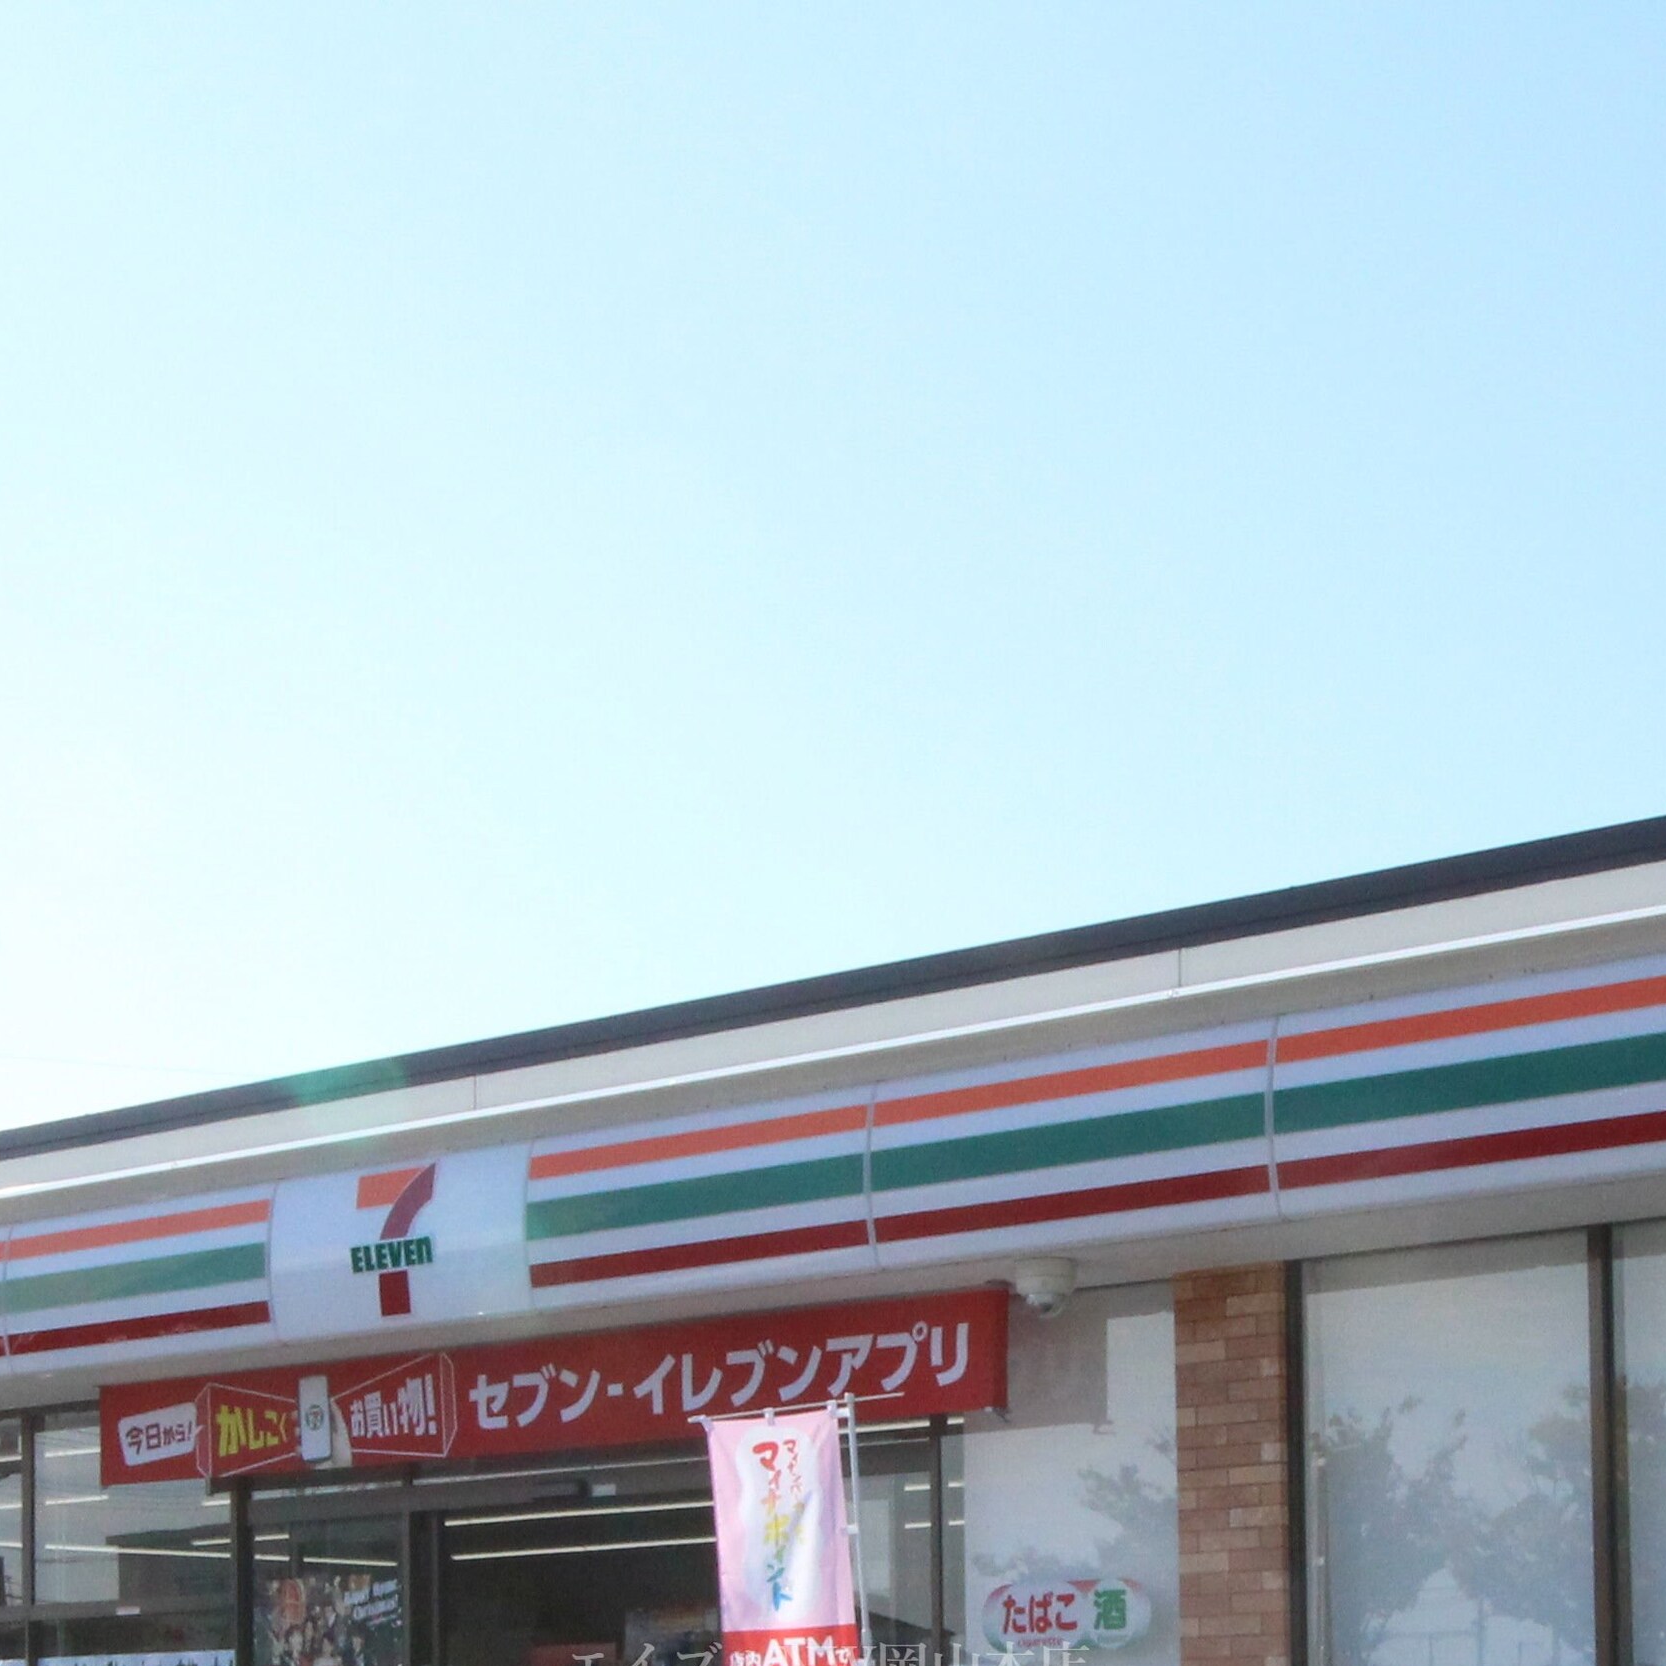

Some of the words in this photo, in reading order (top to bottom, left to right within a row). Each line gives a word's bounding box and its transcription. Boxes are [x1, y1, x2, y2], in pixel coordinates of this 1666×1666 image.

[216, 1404, 286, 1457] かしこく
[752, 1440, 792, 1612] マイナポイント
[1003, 1591, 1078, 1634] たばこ
[1094, 1589, 1127, 1630] 酒
